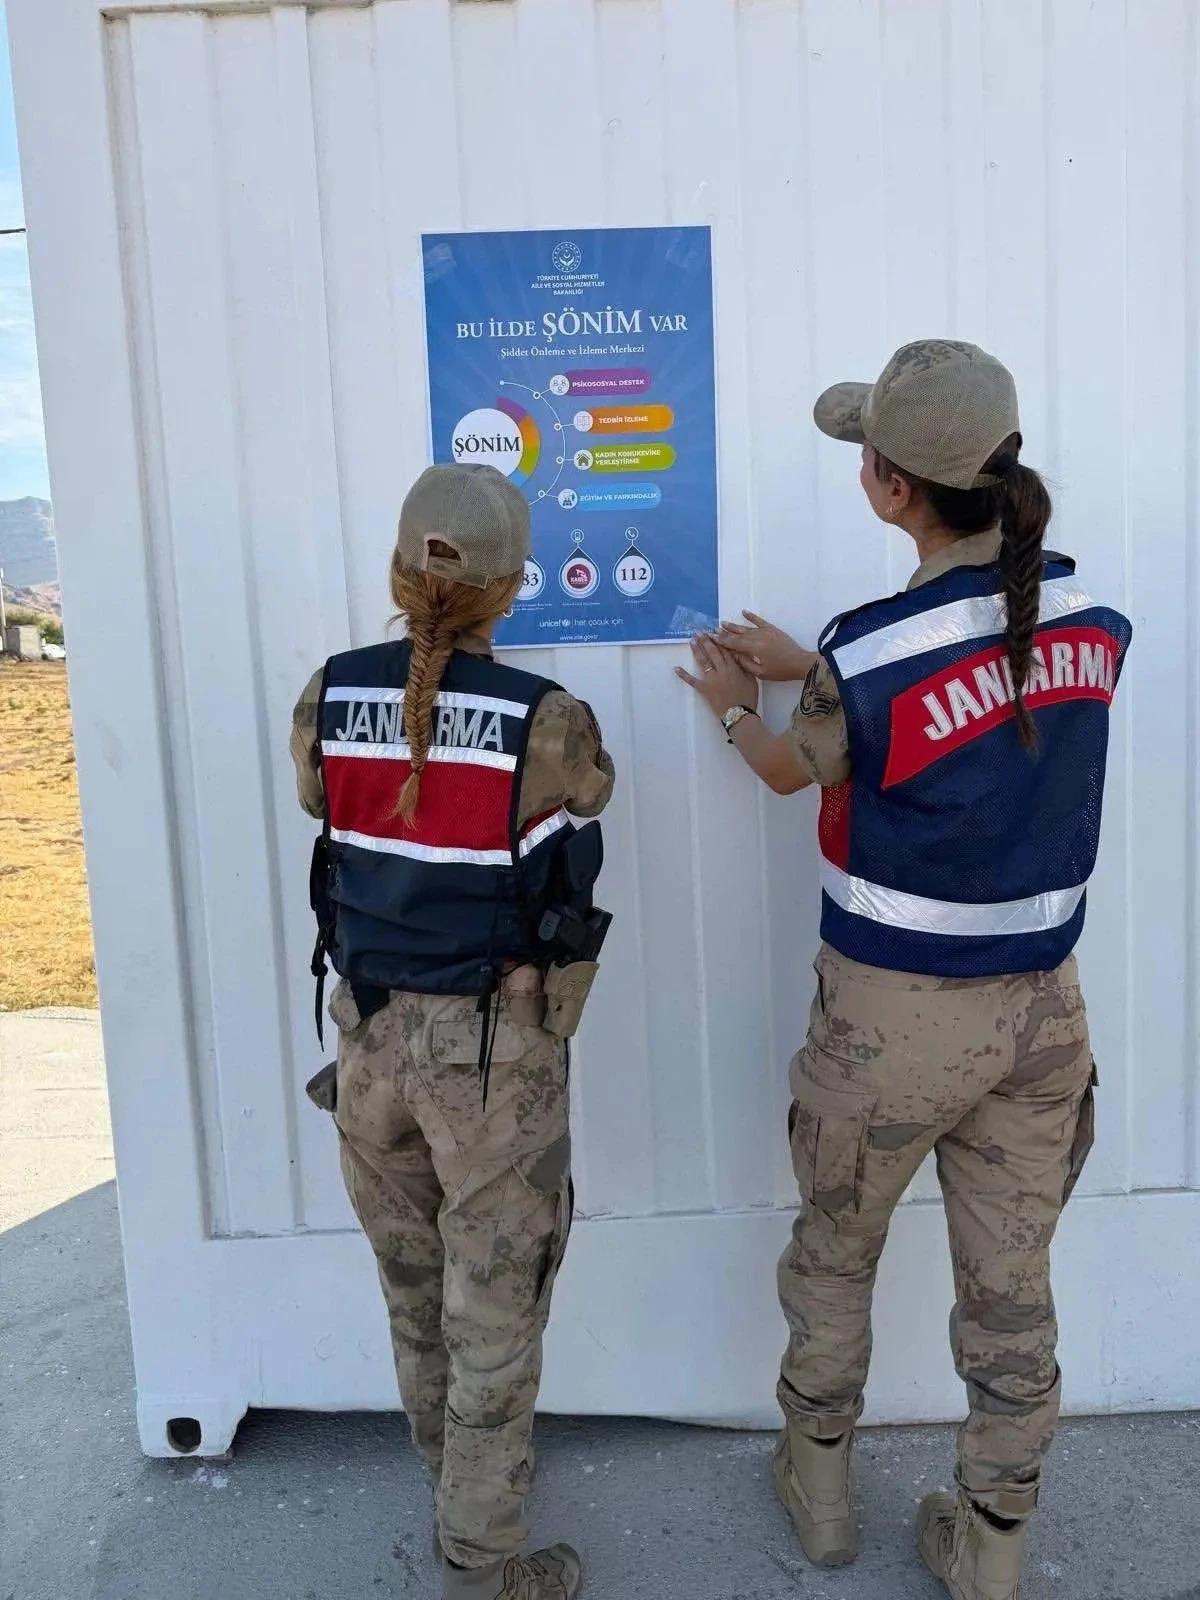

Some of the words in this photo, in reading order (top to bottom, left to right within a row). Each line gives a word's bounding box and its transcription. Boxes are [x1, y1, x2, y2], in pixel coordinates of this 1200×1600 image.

[456, 322, 485, 338] BU
[488, 317, 537, 337] İLDE
[543, 305, 643, 343] ŞÖNİM
[649, 314, 689, 332] VAR
[501, 346, 529, 358] Şiddet
[530, 345, 566, 356] Önleme
[567, 348, 577, 356] ve
[579, 344, 608, 355] İzleme
[609, 343, 645, 354] Merkezi
[572, 379, 618, 388] PSİKOSOSYAL
[454, 433, 521, 458] ŞÖNİM
[617, 449, 661, 457] KONUKEVİNE
[595, 458, 640, 466] YERLEŞTİRME
[614, 492, 658, 500] FARKINDALIK
[621, 567, 648, 581] 112
[539, 618, 561, 628] unicef
